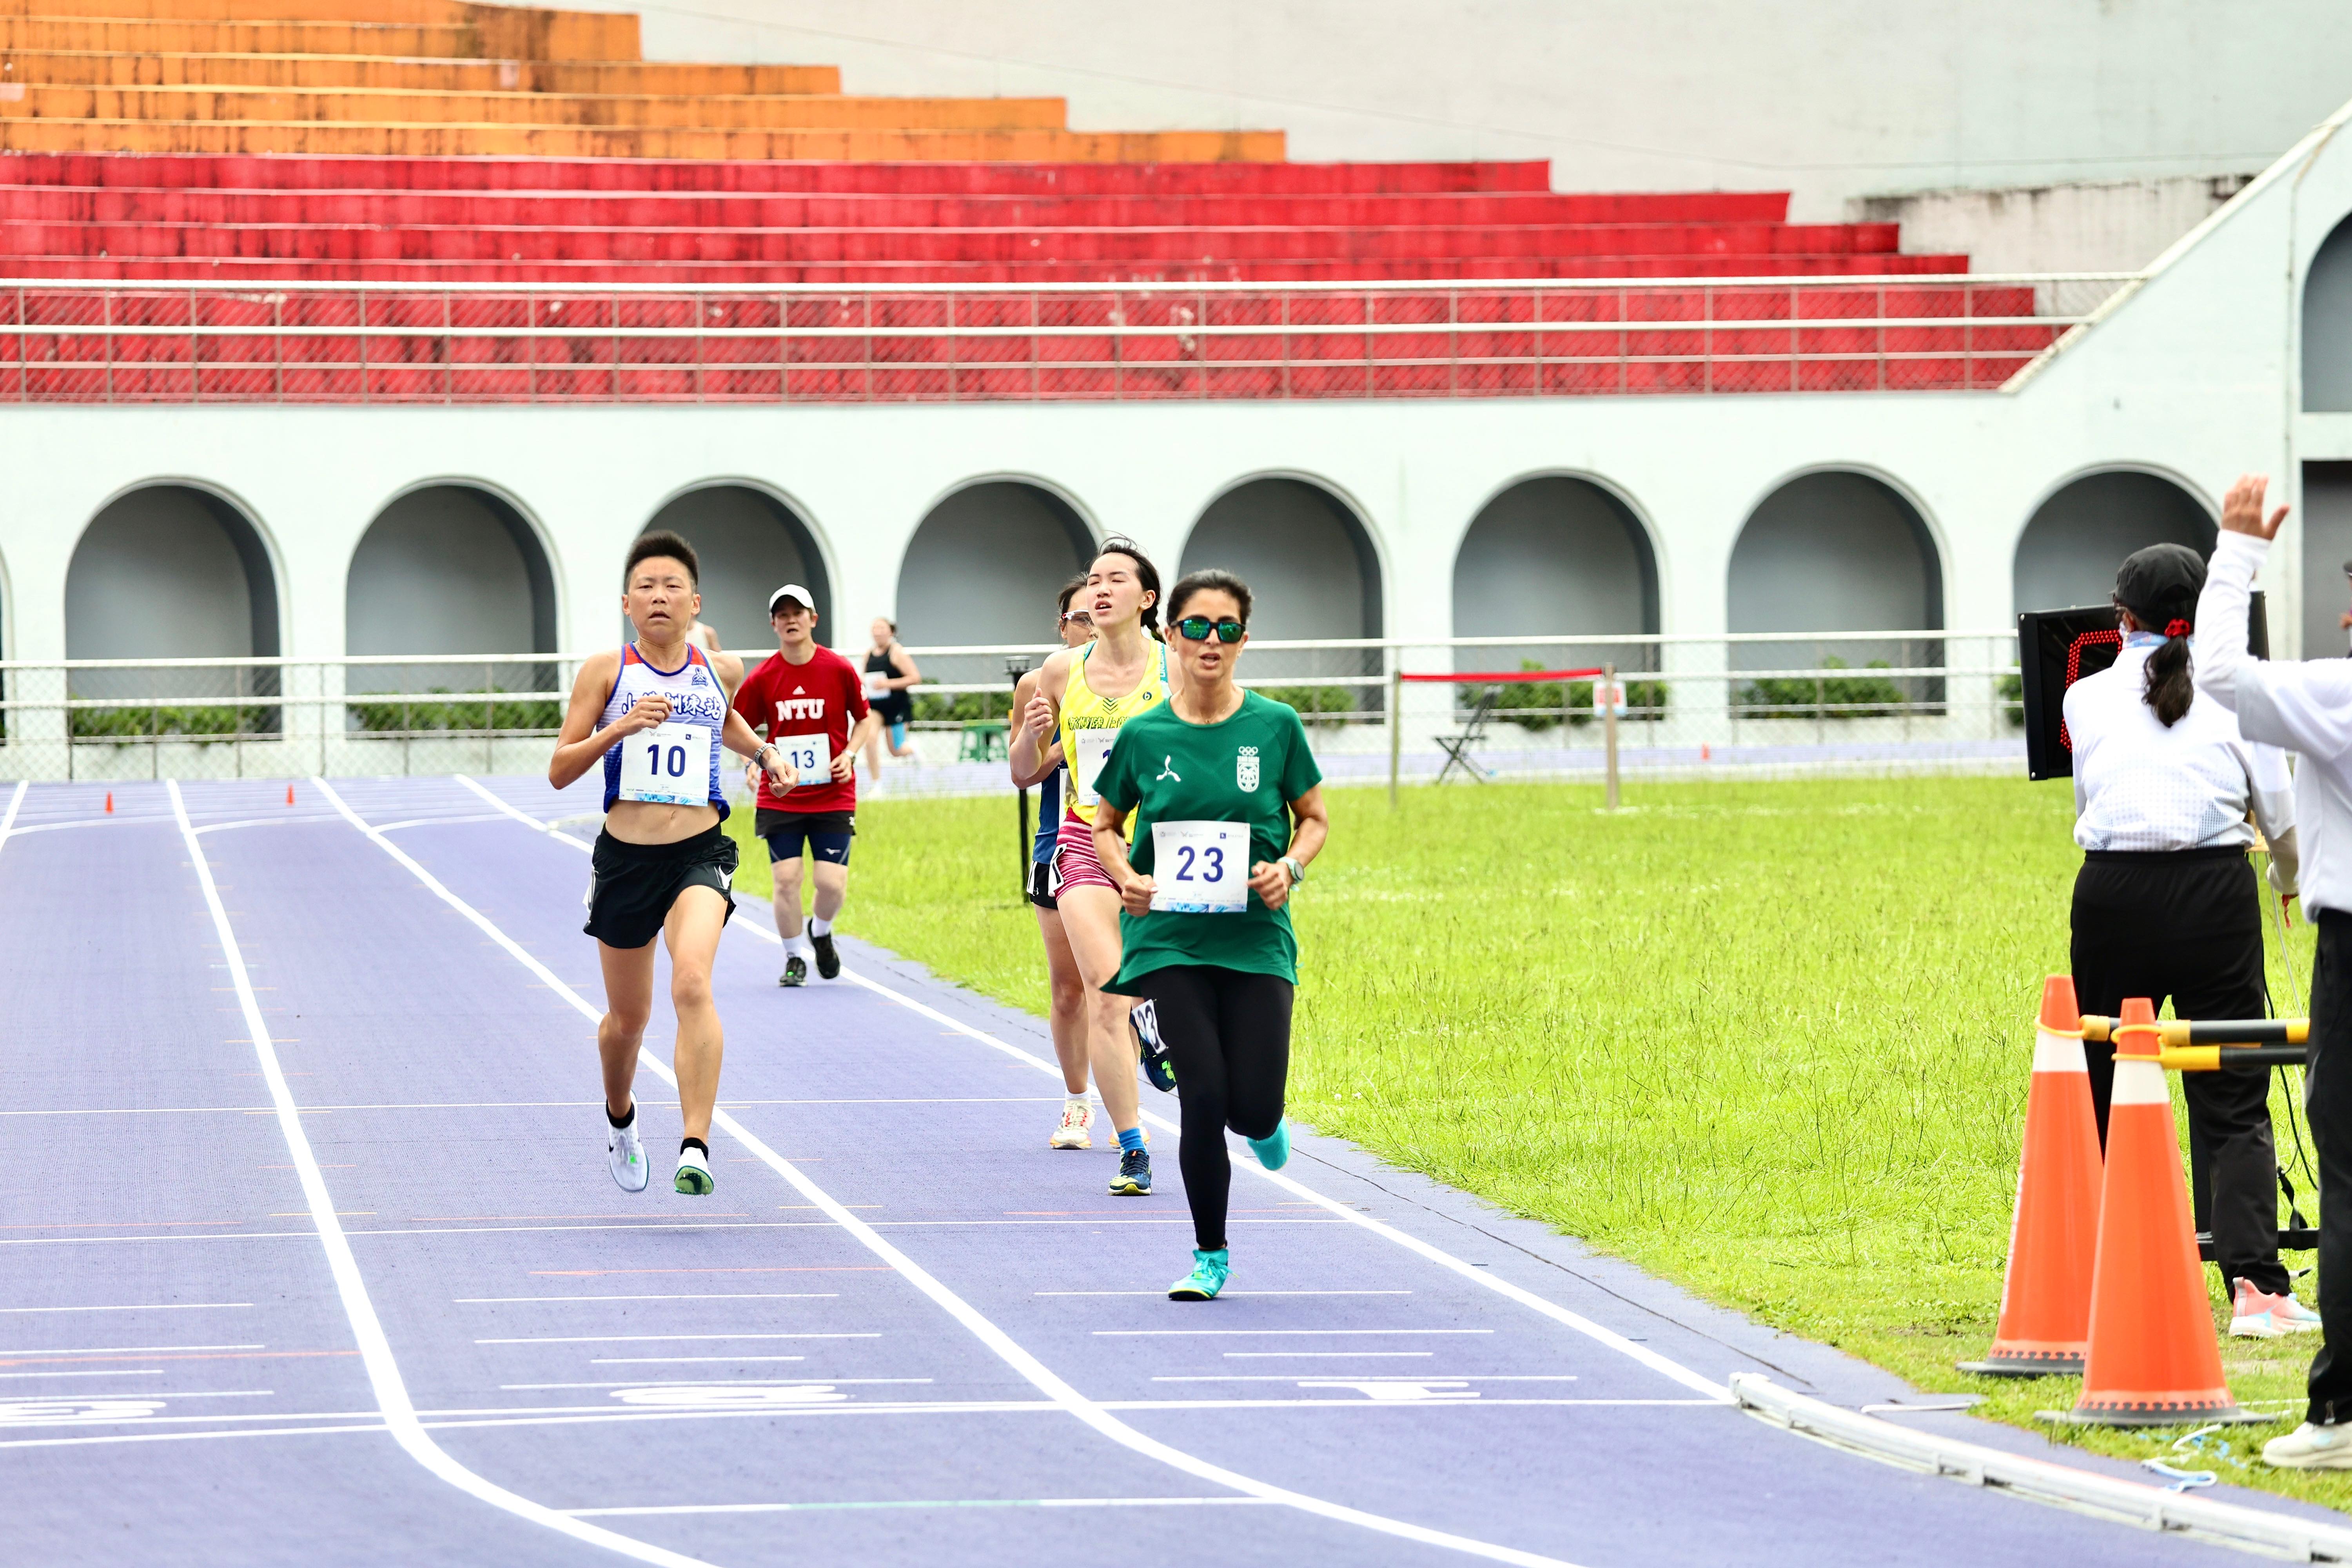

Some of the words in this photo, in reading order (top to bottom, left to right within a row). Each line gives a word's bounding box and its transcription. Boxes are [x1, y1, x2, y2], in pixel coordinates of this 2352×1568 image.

[622, 691, 721, 720] 小訓練站
[775, 699, 825, 722] NTU
[648, 744, 686, 777] 10
[791, 750, 815, 768] 13
[1176, 846, 1224, 882] 23
